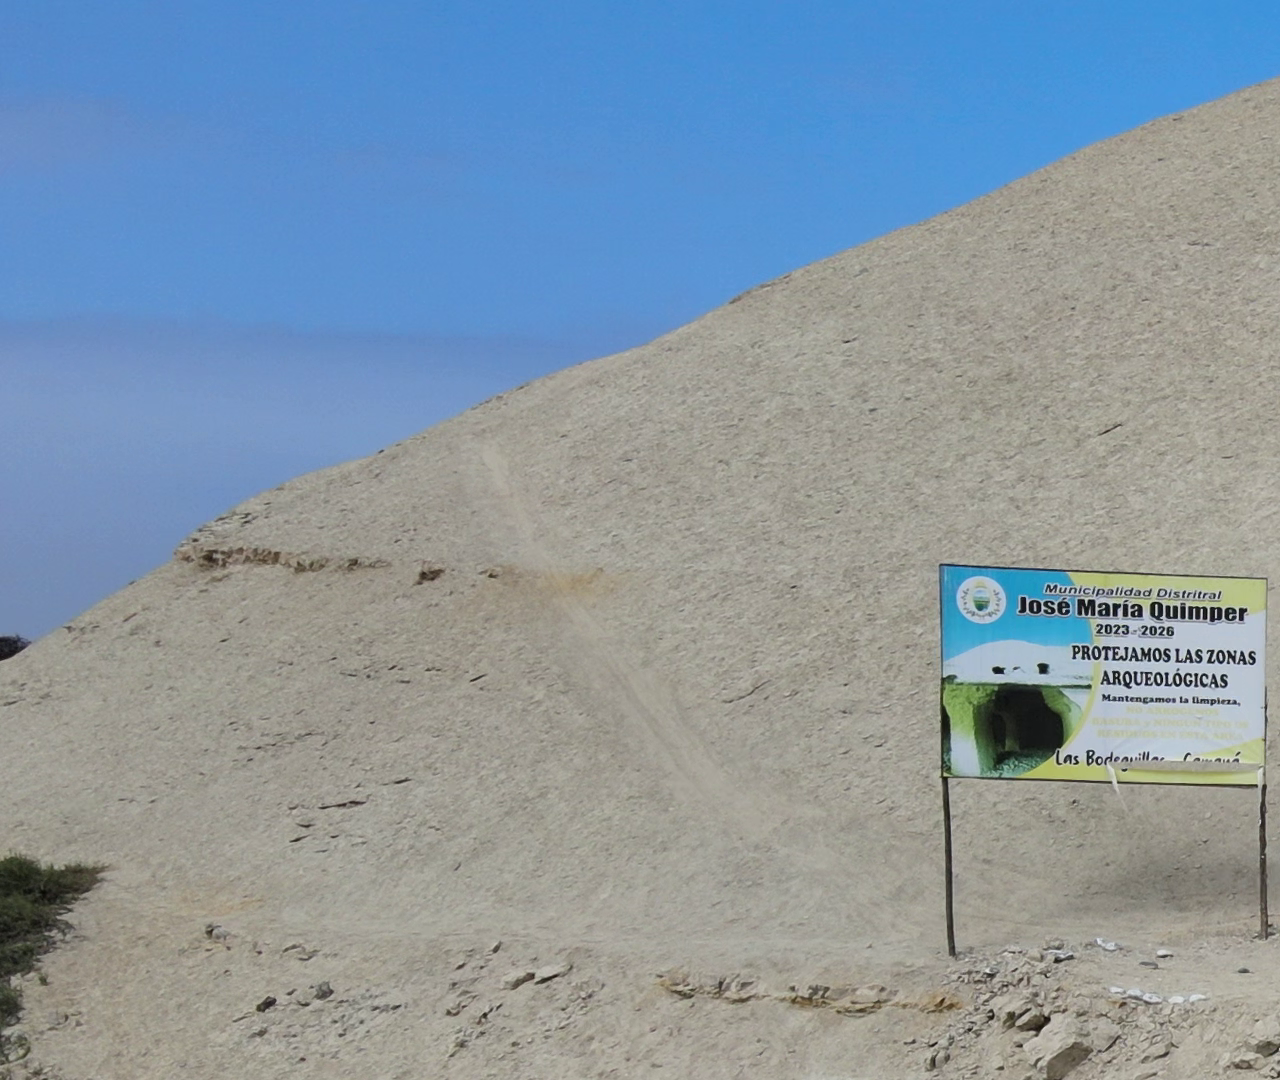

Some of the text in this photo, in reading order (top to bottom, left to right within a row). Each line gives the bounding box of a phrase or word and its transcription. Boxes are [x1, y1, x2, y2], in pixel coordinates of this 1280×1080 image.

[1045, 583, 1222, 601] Municipalidad Distritral
[1017, 596, 1248, 622] José María Quimper
[1095, 623, 1130, 636] 2023
[1141, 625, 1174, 637] 2026
[1071, 645, 1257, 665] PROTEJAMOS LAS ZONAS
[1100, 668, 1229, 689] ARQUEOLÓGICAS
[1102, 694, 1241, 706] Mantengamos la limpieza,
[1055, 749, 1080, 766] Las
